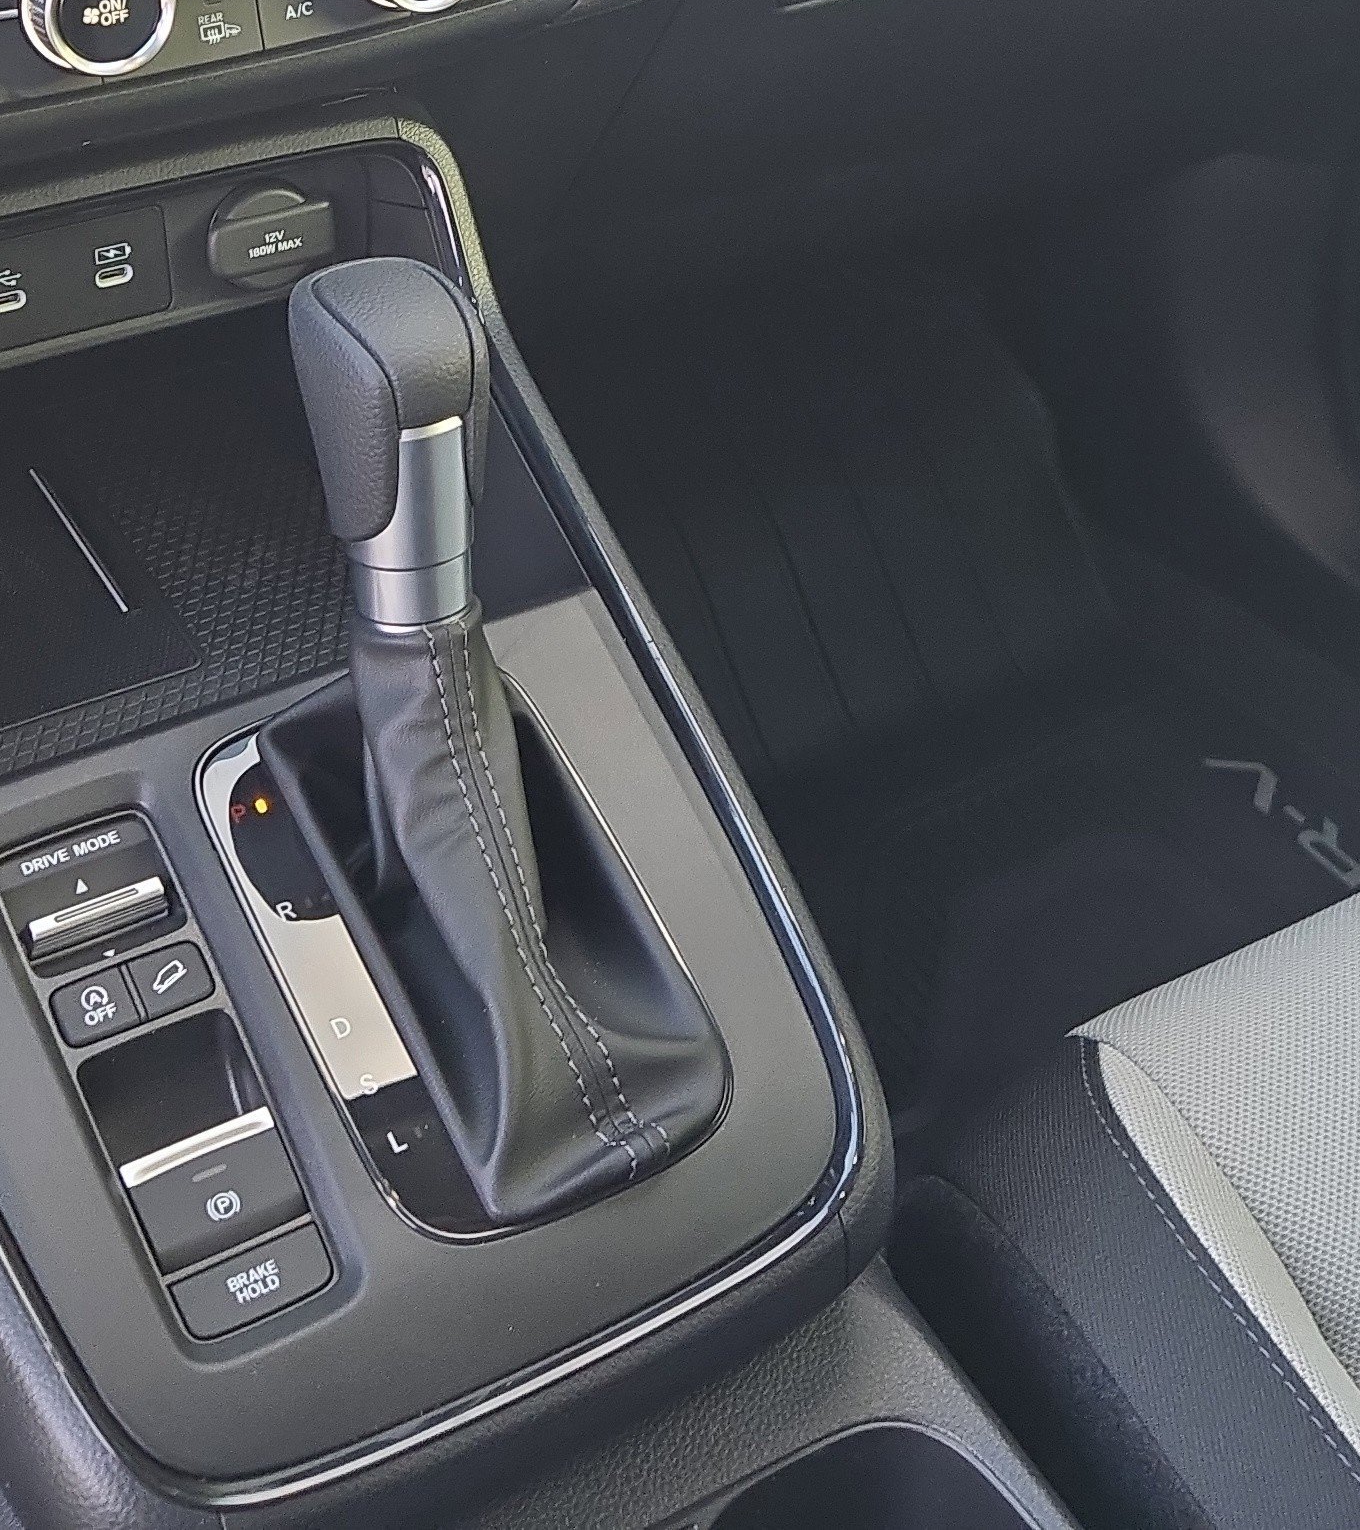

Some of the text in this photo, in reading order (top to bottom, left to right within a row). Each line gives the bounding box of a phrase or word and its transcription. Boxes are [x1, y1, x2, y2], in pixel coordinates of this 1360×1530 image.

[100, 9, 130, 27] OFF
[198, 12, 224, 25] REAR
[285, 1, 314, 20] A/C
[264, 229, 285, 244] 12V
[277, 236, 303, 252] MAX
[230, 803, 247, 824] P
[20, 829, 121, 877] DRIVE MODE
[275, 901, 298, 922] R
[84, 1001, 118, 1026] OFF
[329, 1017, 351, 1040] D
[360, 1073, 379, 1095] S
[386, 1130, 409, 1154] L
[226, 1258, 280, 1293] BRAKE
[235, 1274, 280, 1304] HOLD
